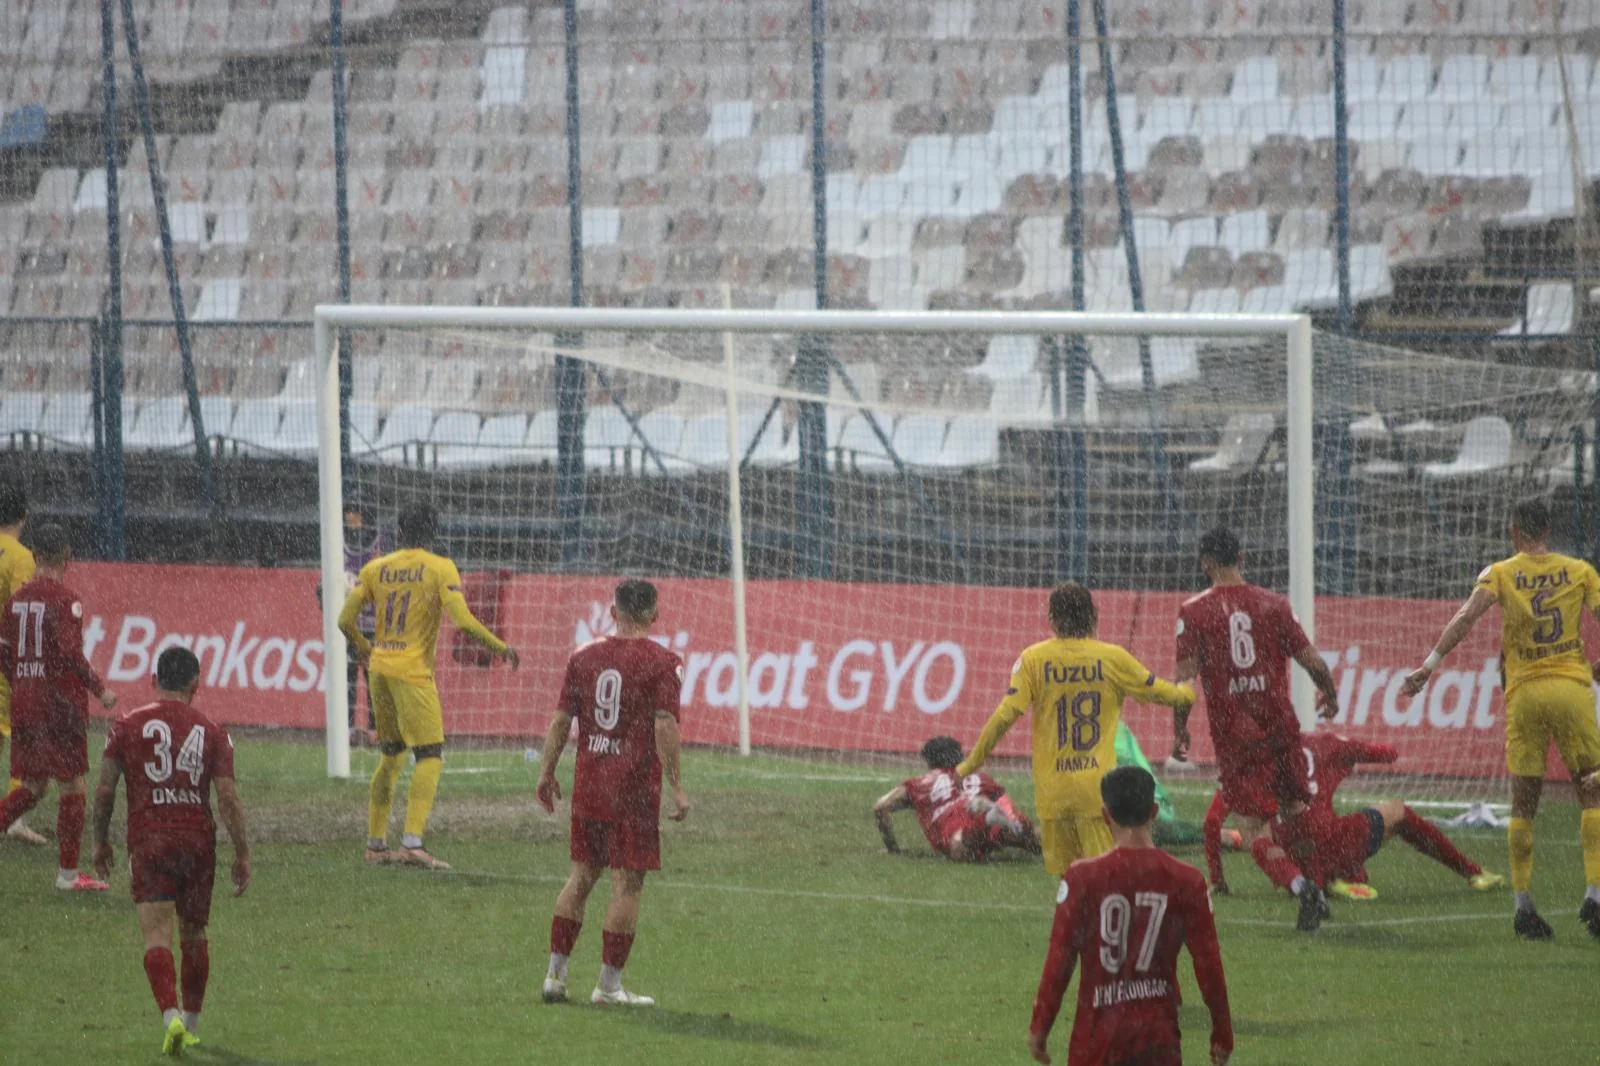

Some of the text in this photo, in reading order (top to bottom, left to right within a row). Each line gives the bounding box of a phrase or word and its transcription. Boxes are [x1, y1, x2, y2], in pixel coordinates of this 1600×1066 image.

[379, 564, 425, 584] fuzul
[12, 601, 46, 658] 77
[385, 590, 411, 636] 11
[1229, 611, 1256, 668] 6
[1531, 590, 1563, 644] 5
[595, 668, 622, 731] 9
[826, 639, 967, 715] GYO
[1043, 660, 1105, 684] fuzul
[1055, 692, 1101, 752] 18
[142, 719, 205, 787] 34
[152, 787, 202, 805] OKAN
[1100, 892, 1169, 973] 97
